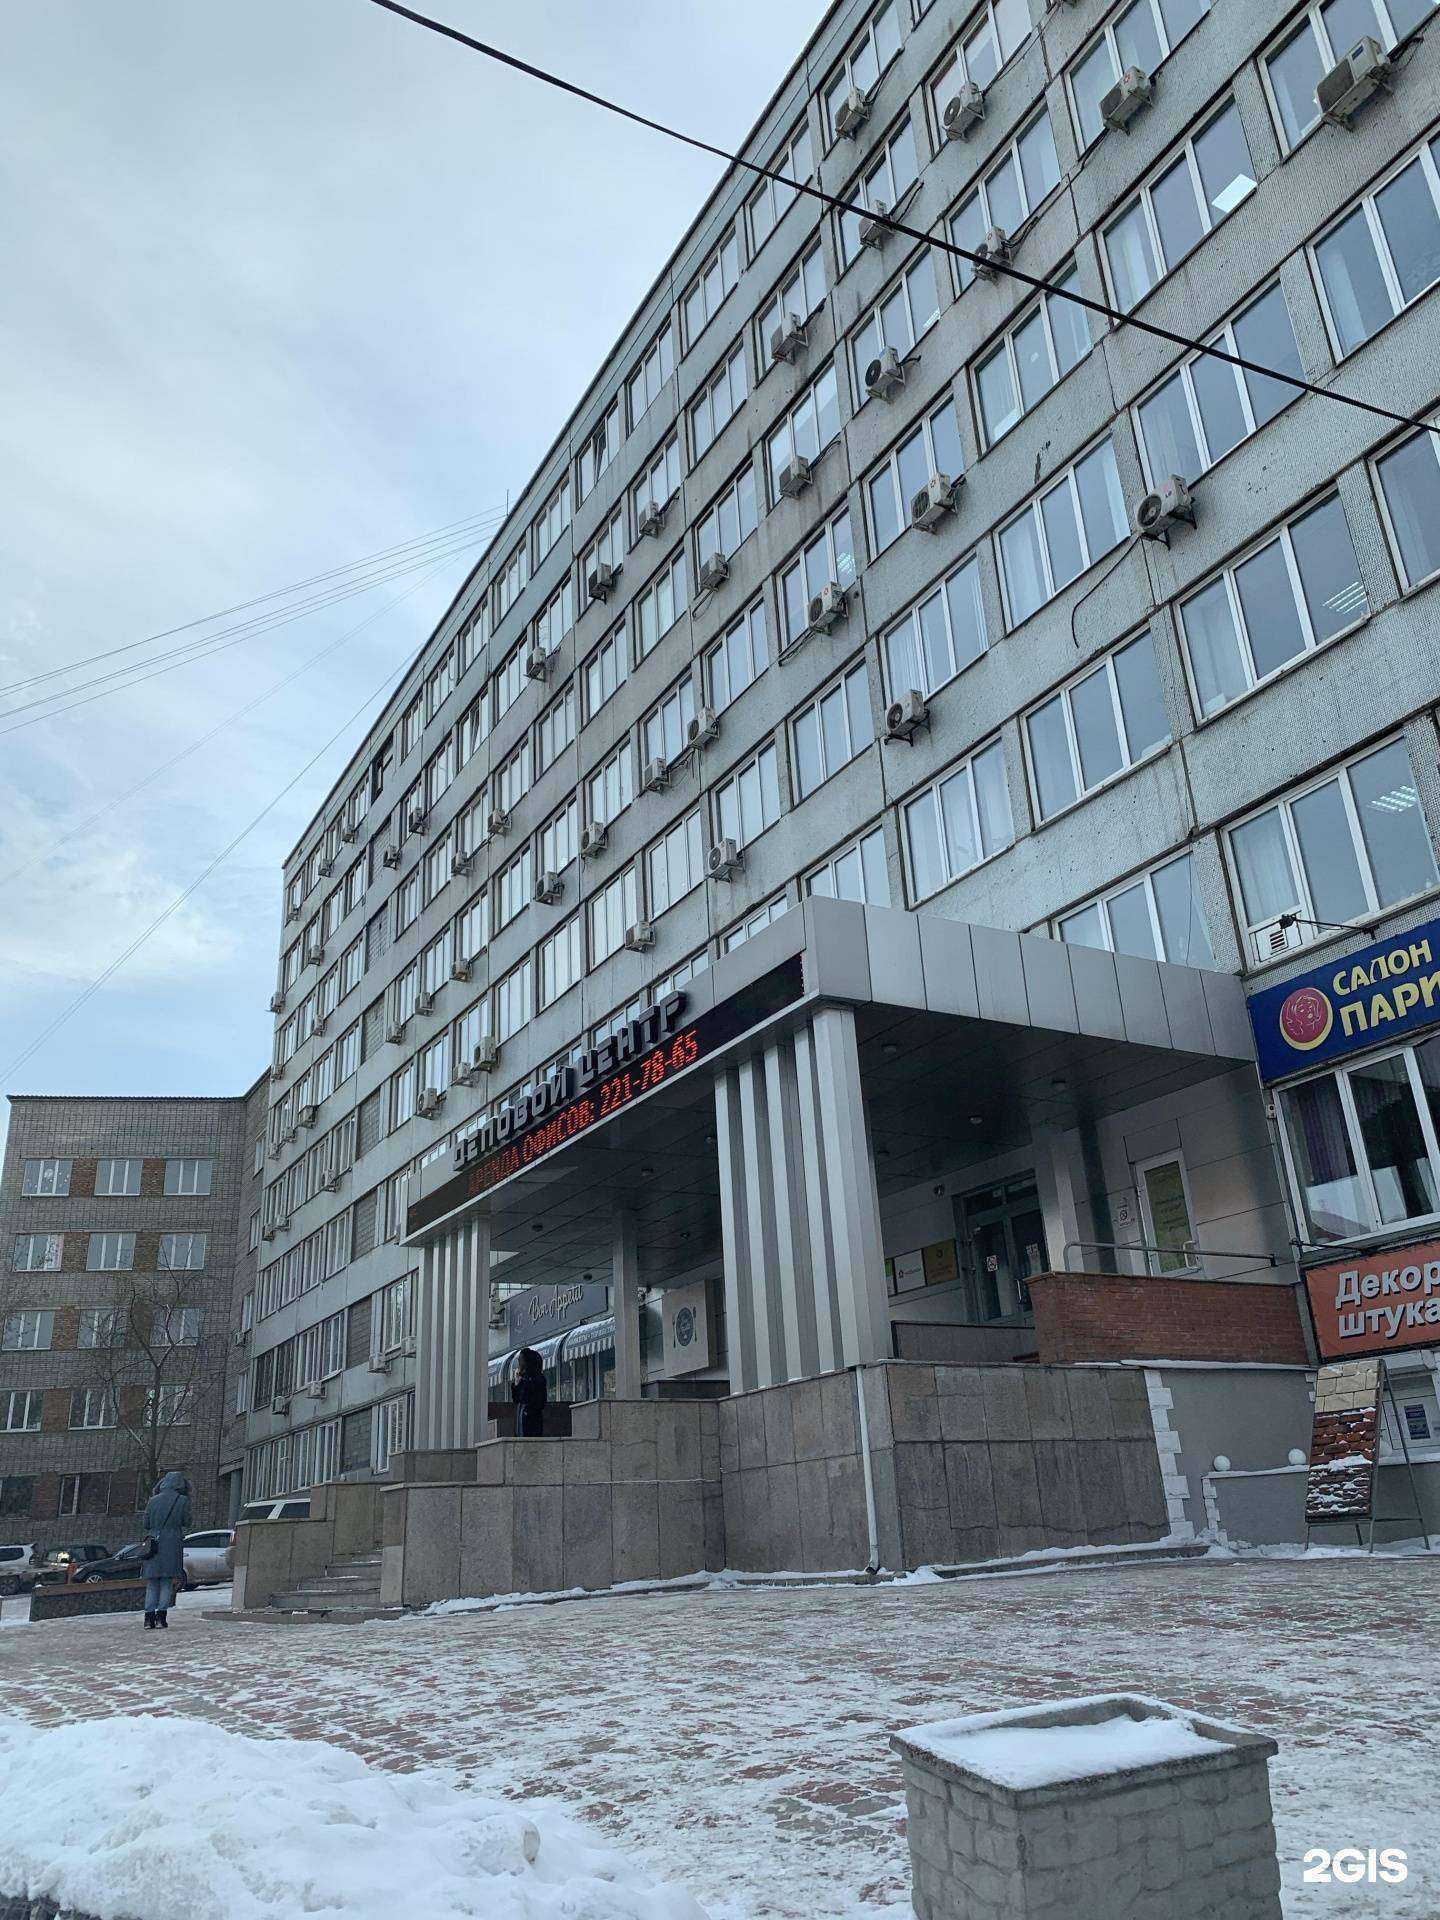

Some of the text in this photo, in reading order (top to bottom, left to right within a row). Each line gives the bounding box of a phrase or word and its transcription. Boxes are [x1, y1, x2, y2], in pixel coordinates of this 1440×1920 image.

[1333, 939, 1432, 996] САЛОН
[452, 989, 688, 1171] ДЕЛОВОЙ ЦЕНТР
[1335, 1261, 1440, 1310] Декор
